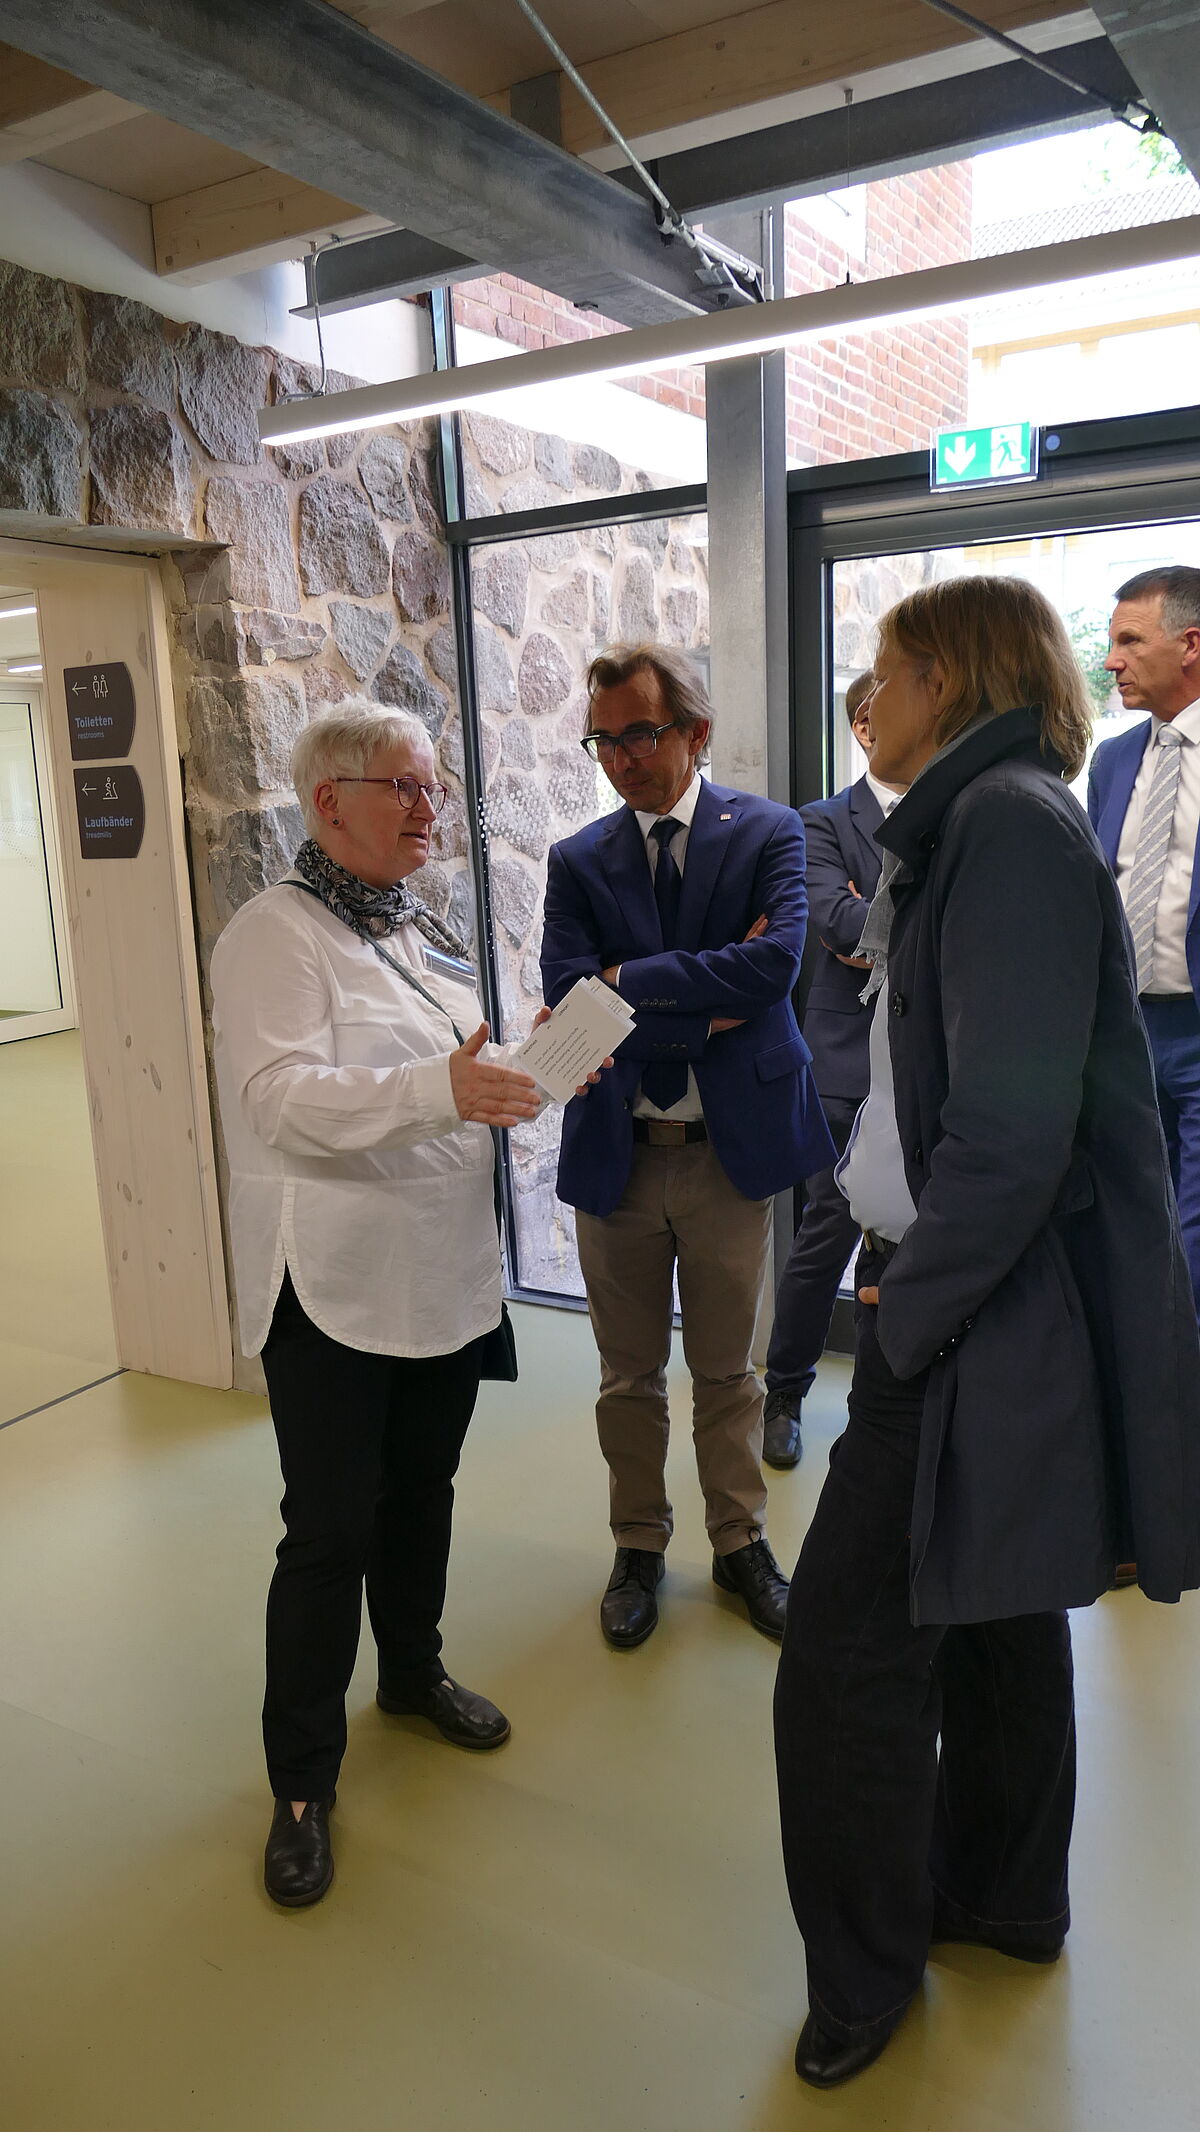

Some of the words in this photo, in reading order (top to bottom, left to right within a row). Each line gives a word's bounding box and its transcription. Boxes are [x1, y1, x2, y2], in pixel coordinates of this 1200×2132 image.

[75, 716, 113, 728] Toiletten
[77, 731, 105, 740] restrooms
[85, 816, 134, 828] Laufbänder
